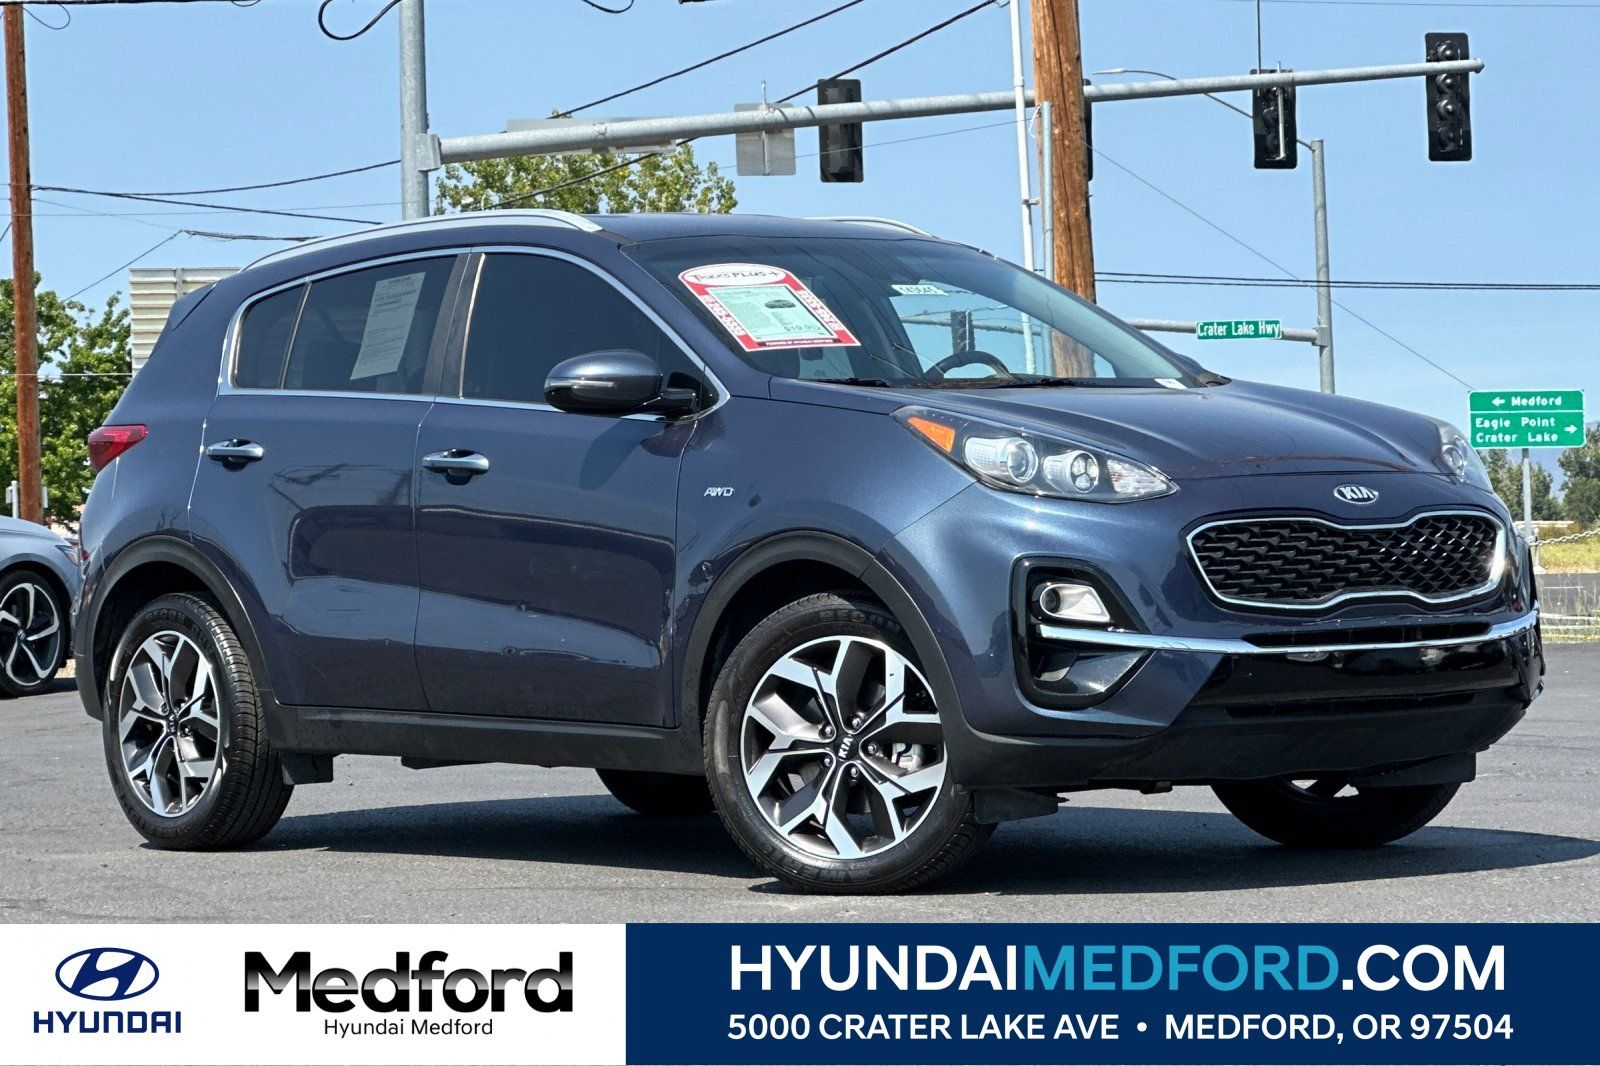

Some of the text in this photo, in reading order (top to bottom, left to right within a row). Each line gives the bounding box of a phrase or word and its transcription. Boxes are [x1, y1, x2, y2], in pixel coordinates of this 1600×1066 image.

[1197, 320, 1280, 338] Crater Lake Hwy
[1511, 395, 1562, 406] Medford
[1475, 416, 1556, 430] Eagle Point
[1476, 431, 1559, 443] Crater Lake
[703, 486, 735, 497] AWD
[1339, 486, 1376, 500] KIA
[837, 736, 854, 759] KIA
